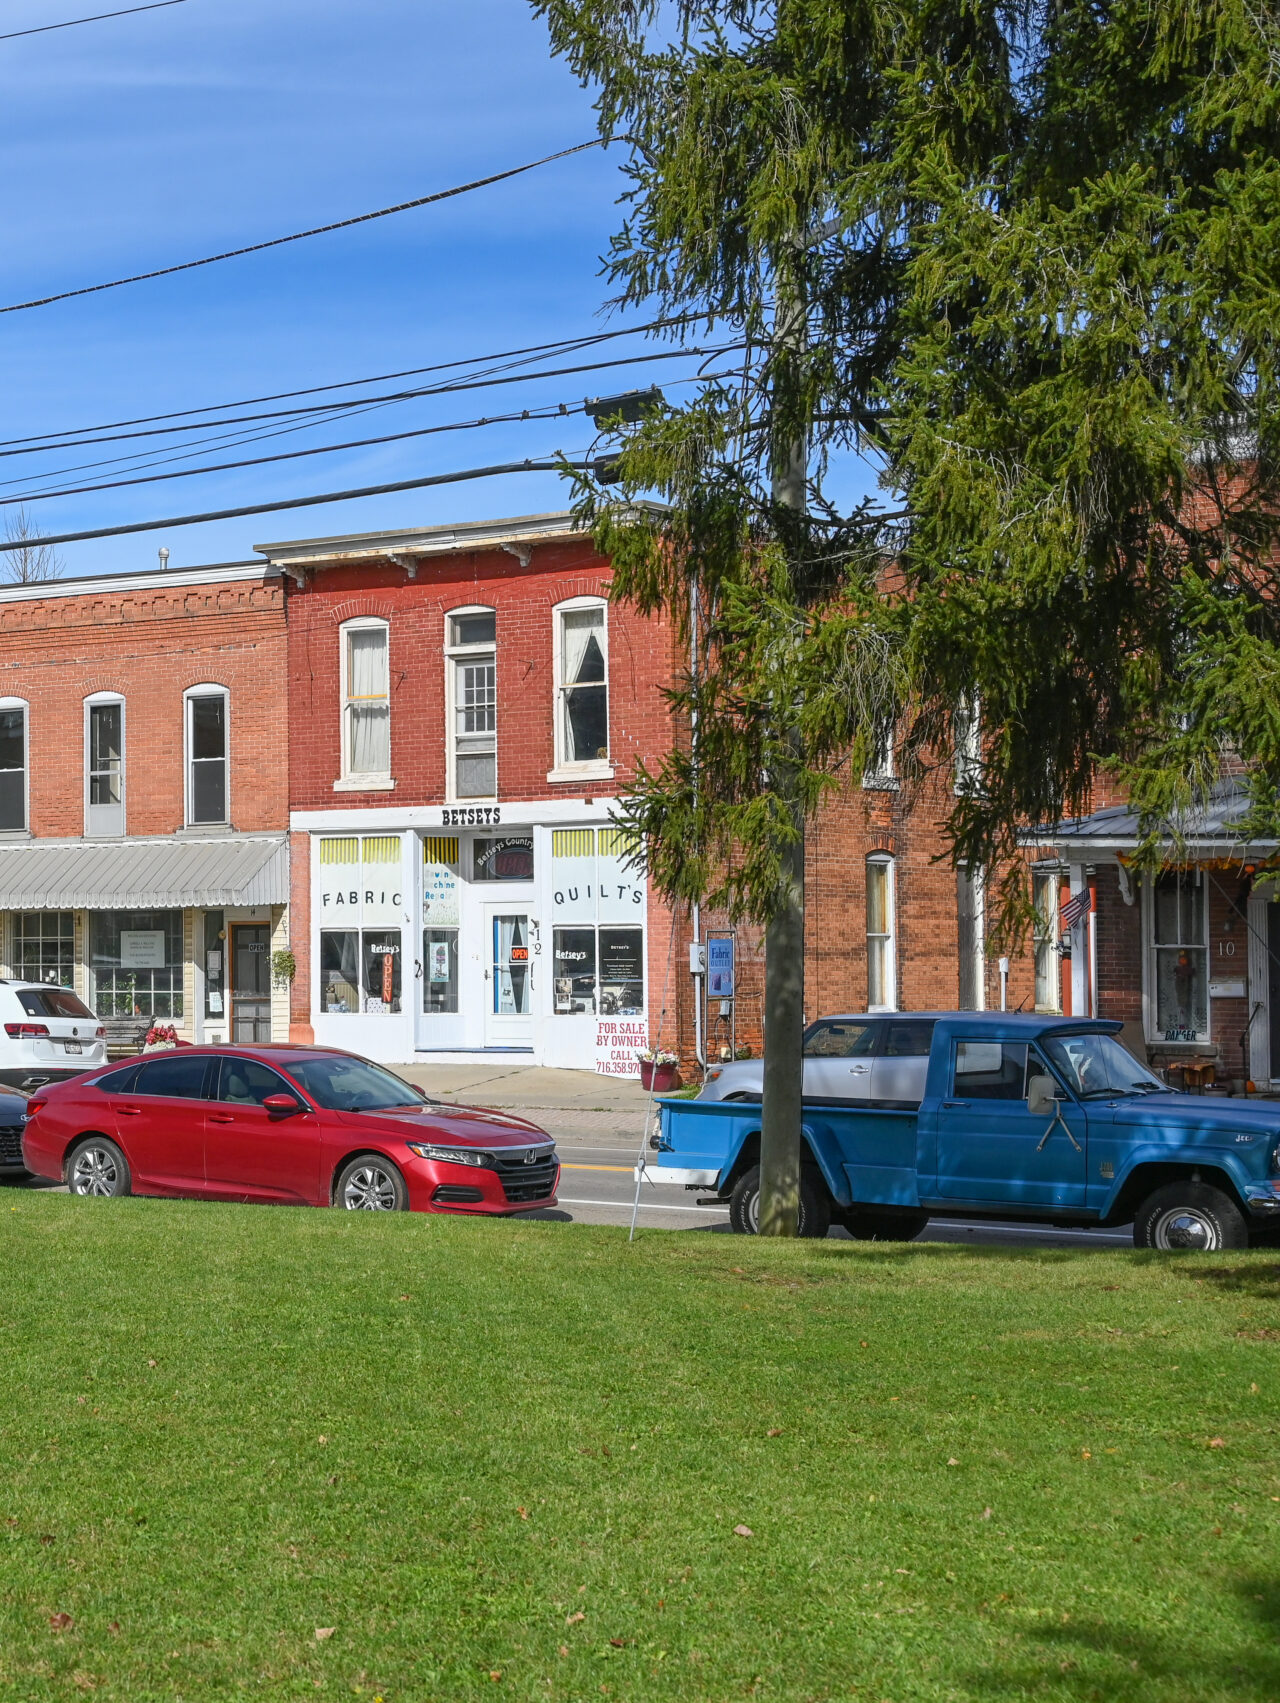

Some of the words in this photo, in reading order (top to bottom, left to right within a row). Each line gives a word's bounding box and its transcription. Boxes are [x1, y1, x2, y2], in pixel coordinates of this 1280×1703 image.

[442, 807, 501, 825] BETSEYS
[505, 837, 534, 850] Country
[322, 890, 402, 907] FABRIC
[554, 884, 643, 905] QUILT'S
[534, 929, 542, 955] 12
[371, 944, 400, 955] Betsey's
[512, 949, 528, 959] OPEN
[711, 948, 730, 959] Fabric
[1219, 941, 1235, 956] 10
[555, 950, 587, 961] Betsey's
[383, 954, 393, 1003] OPEN
[598, 1022, 618, 1034] FOR
[619, 1022, 645, 1034] SALE
[596, 1035, 609, 1047] BY
[611, 1035, 647, 1047] OWNER
[1164, 1030, 1196, 1041] DANGER
[610, 1050, 633, 1061] CALL
